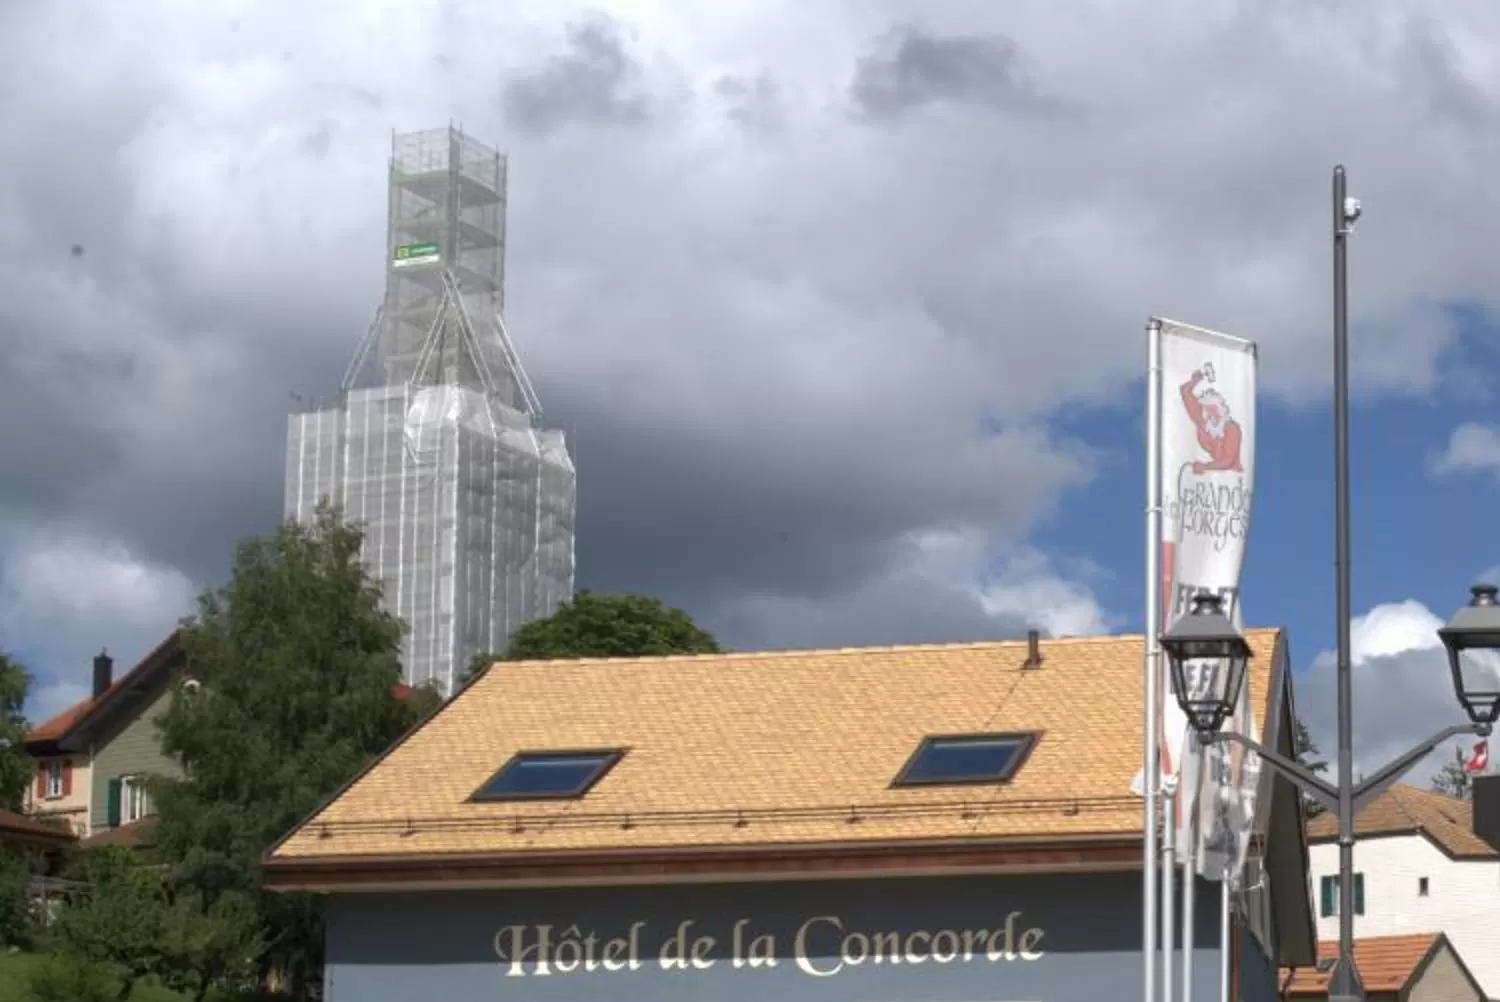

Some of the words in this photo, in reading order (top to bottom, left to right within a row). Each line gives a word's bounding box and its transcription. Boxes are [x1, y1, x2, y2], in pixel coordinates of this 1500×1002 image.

[493, 920, 648, 977] Hôtel
[658, 919, 718, 969] de
[731, 918, 780, 969] la
[793, 911, 1046, 977] Concorde
